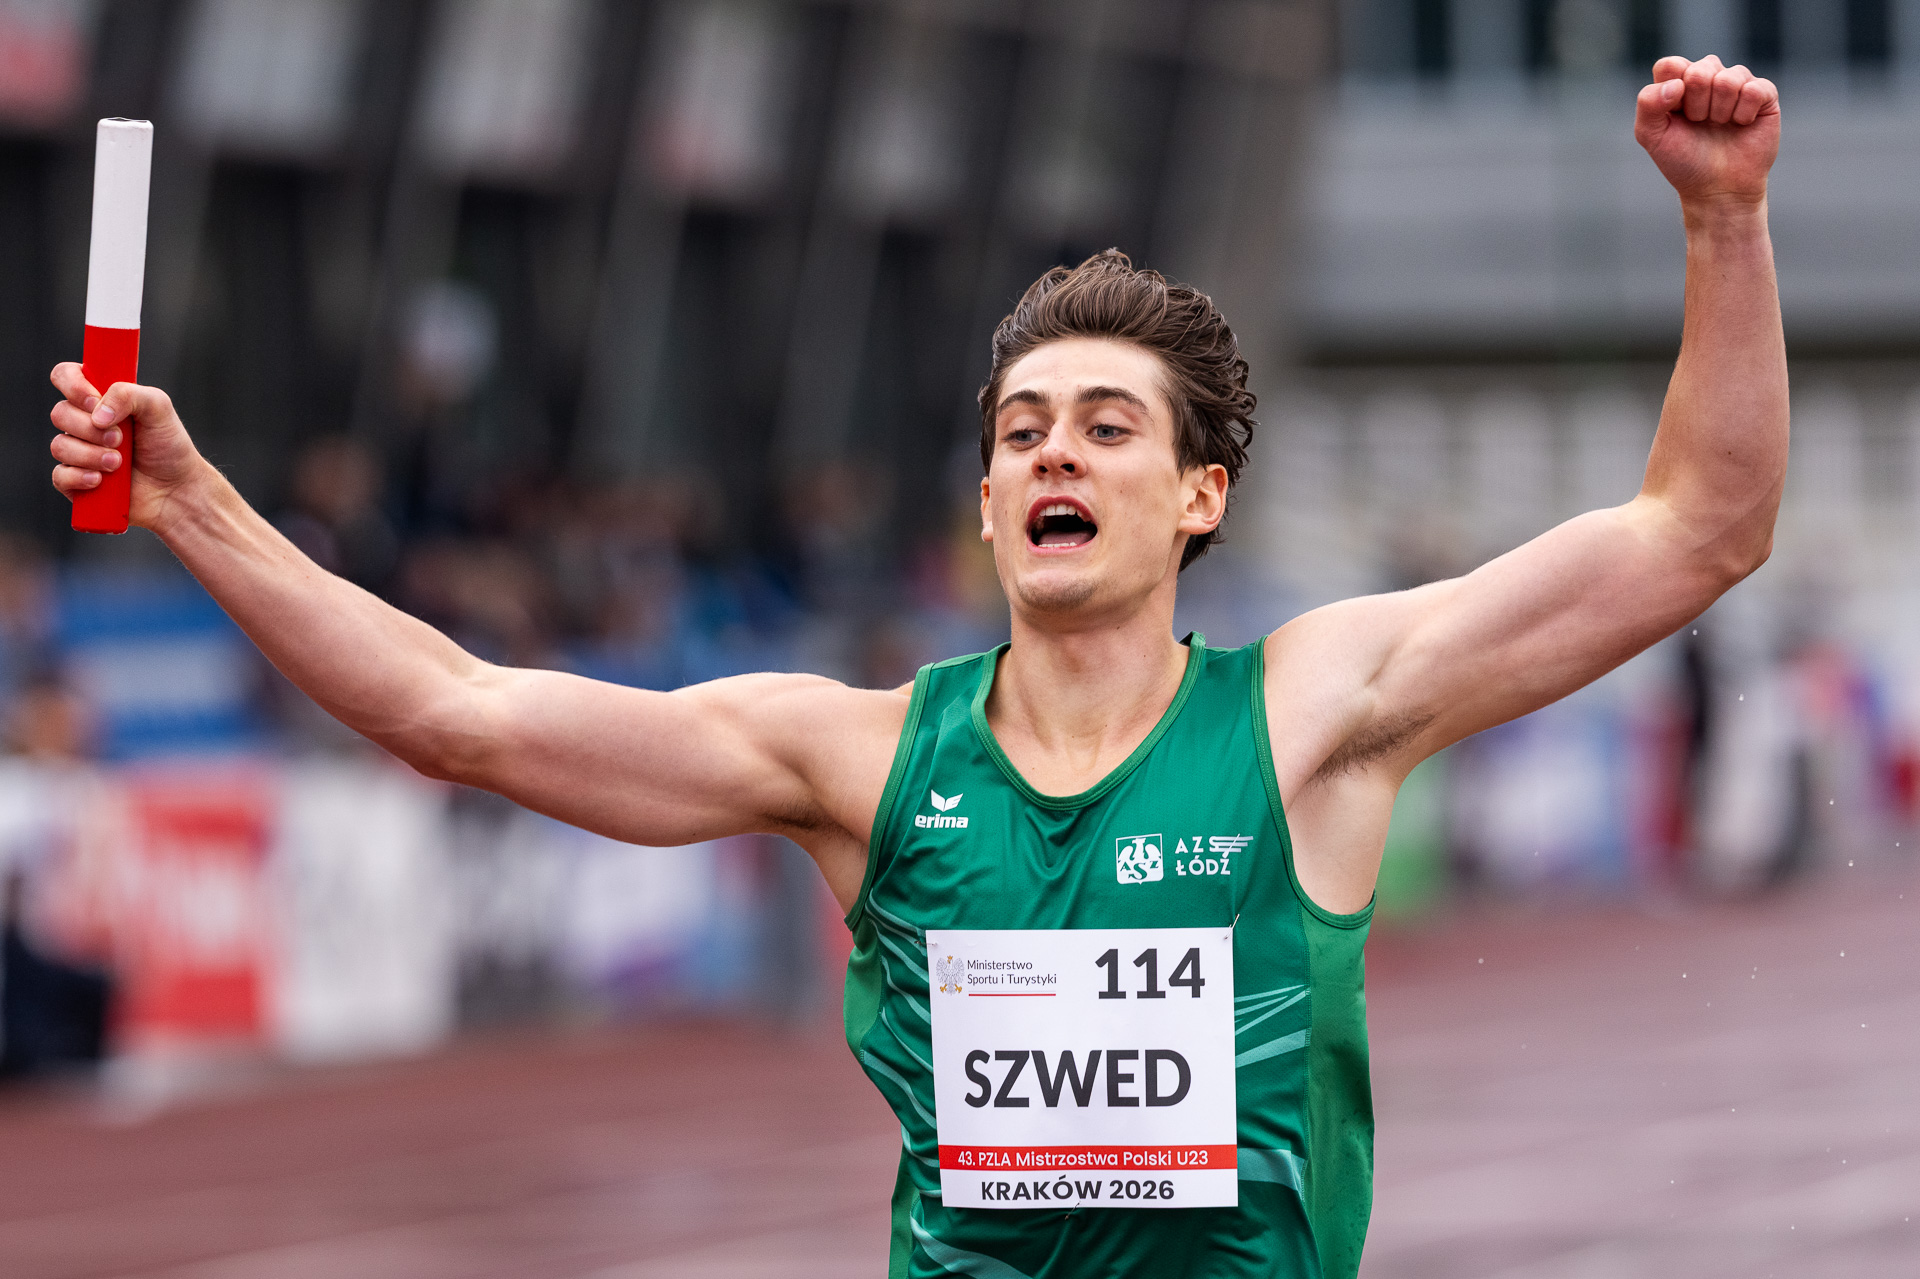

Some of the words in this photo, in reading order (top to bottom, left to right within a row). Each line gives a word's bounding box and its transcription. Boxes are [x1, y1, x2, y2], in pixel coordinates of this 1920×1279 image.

[915, 814, 969, 828] erima
[1175, 835, 1254, 855] AZS
[1176, 855, 1231, 876] ŁÓDŹ
[967, 959, 1033, 971] Ministerstwo
[1095, 947, 1206, 1000] 114
[967, 973, 998, 987] Sportu
[1001, 974, 1004, 985] i
[1008, 973, 1057, 986] Turystyki
[964, 1049, 1192, 1109] SZWED
[958, 1151, 976, 1167] 43.
[978, 1152, 1011, 1167] PZLA
[1016, 1151, 1118, 1167] Mistrzostwa
[1123, 1150, 1172, 1166] Polski
[1177, 1150, 1209, 1166] U23
[981, 1174, 1103, 1201] KRAKÓW
[1109, 1179, 1175, 1200] 2026
